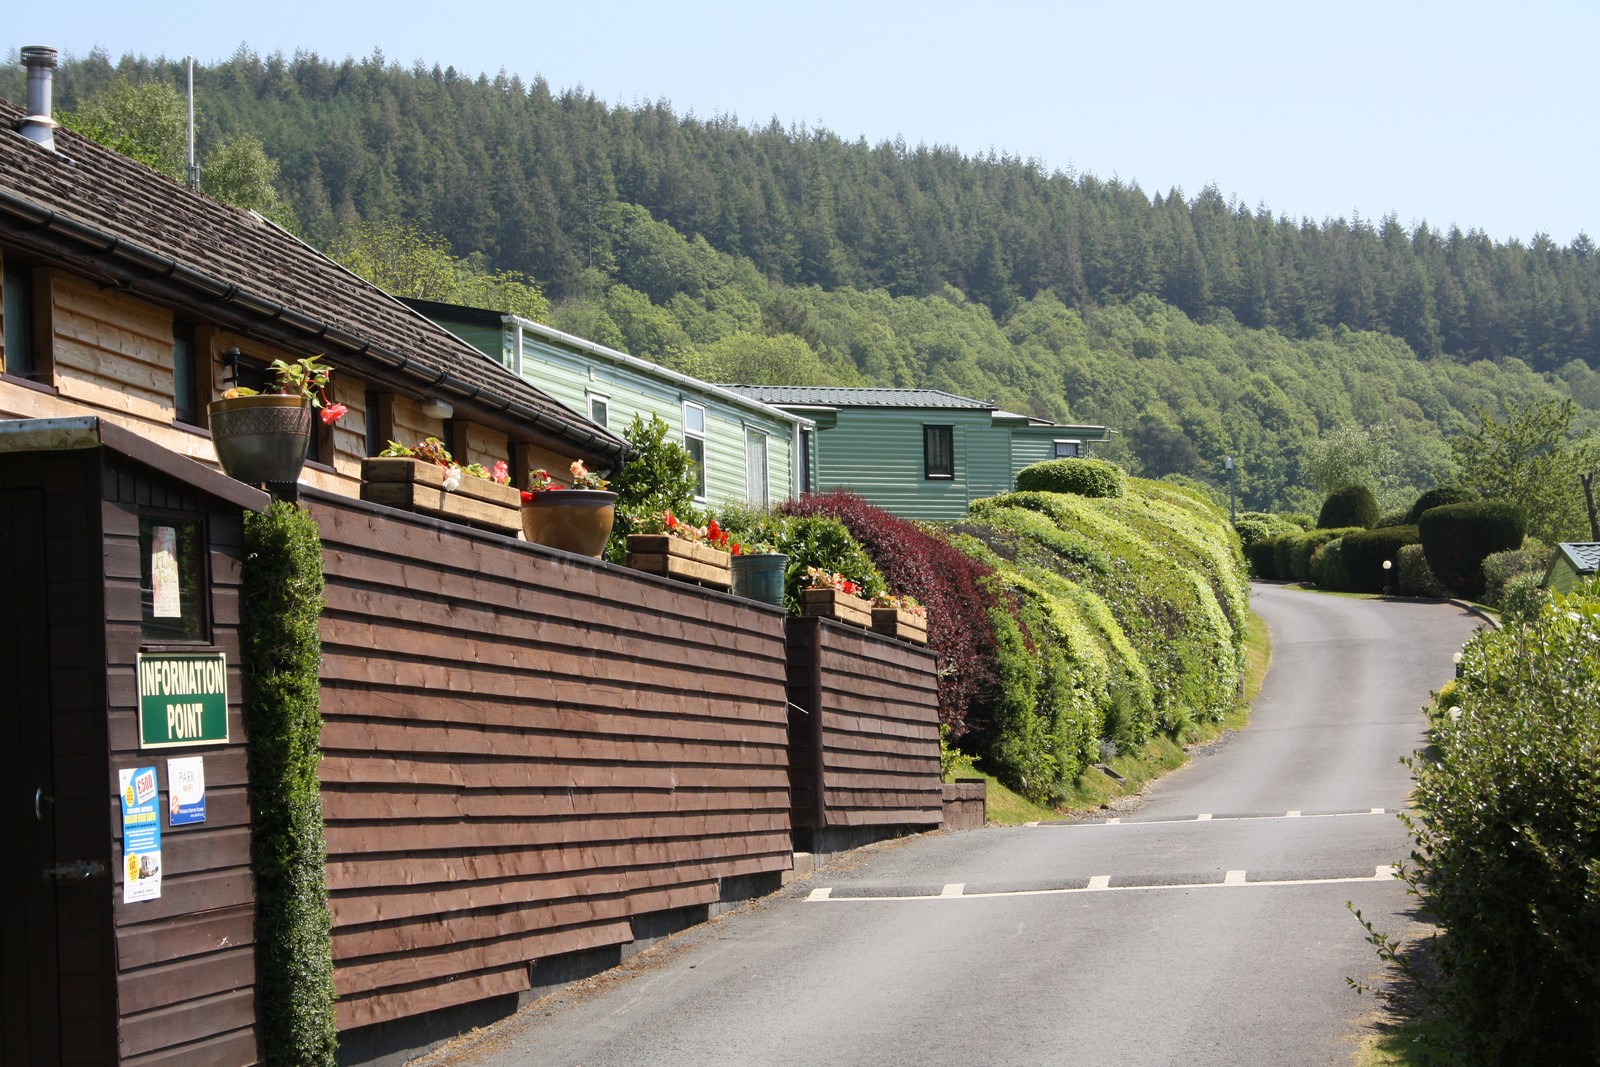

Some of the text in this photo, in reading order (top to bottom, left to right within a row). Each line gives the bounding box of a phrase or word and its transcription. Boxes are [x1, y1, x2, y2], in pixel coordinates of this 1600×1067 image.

[141, 660, 224, 696] INFORMATION
[166, 703, 203, 739] POINT
[137, 774, 153, 795] £500
[179, 771, 195, 784] PARK
